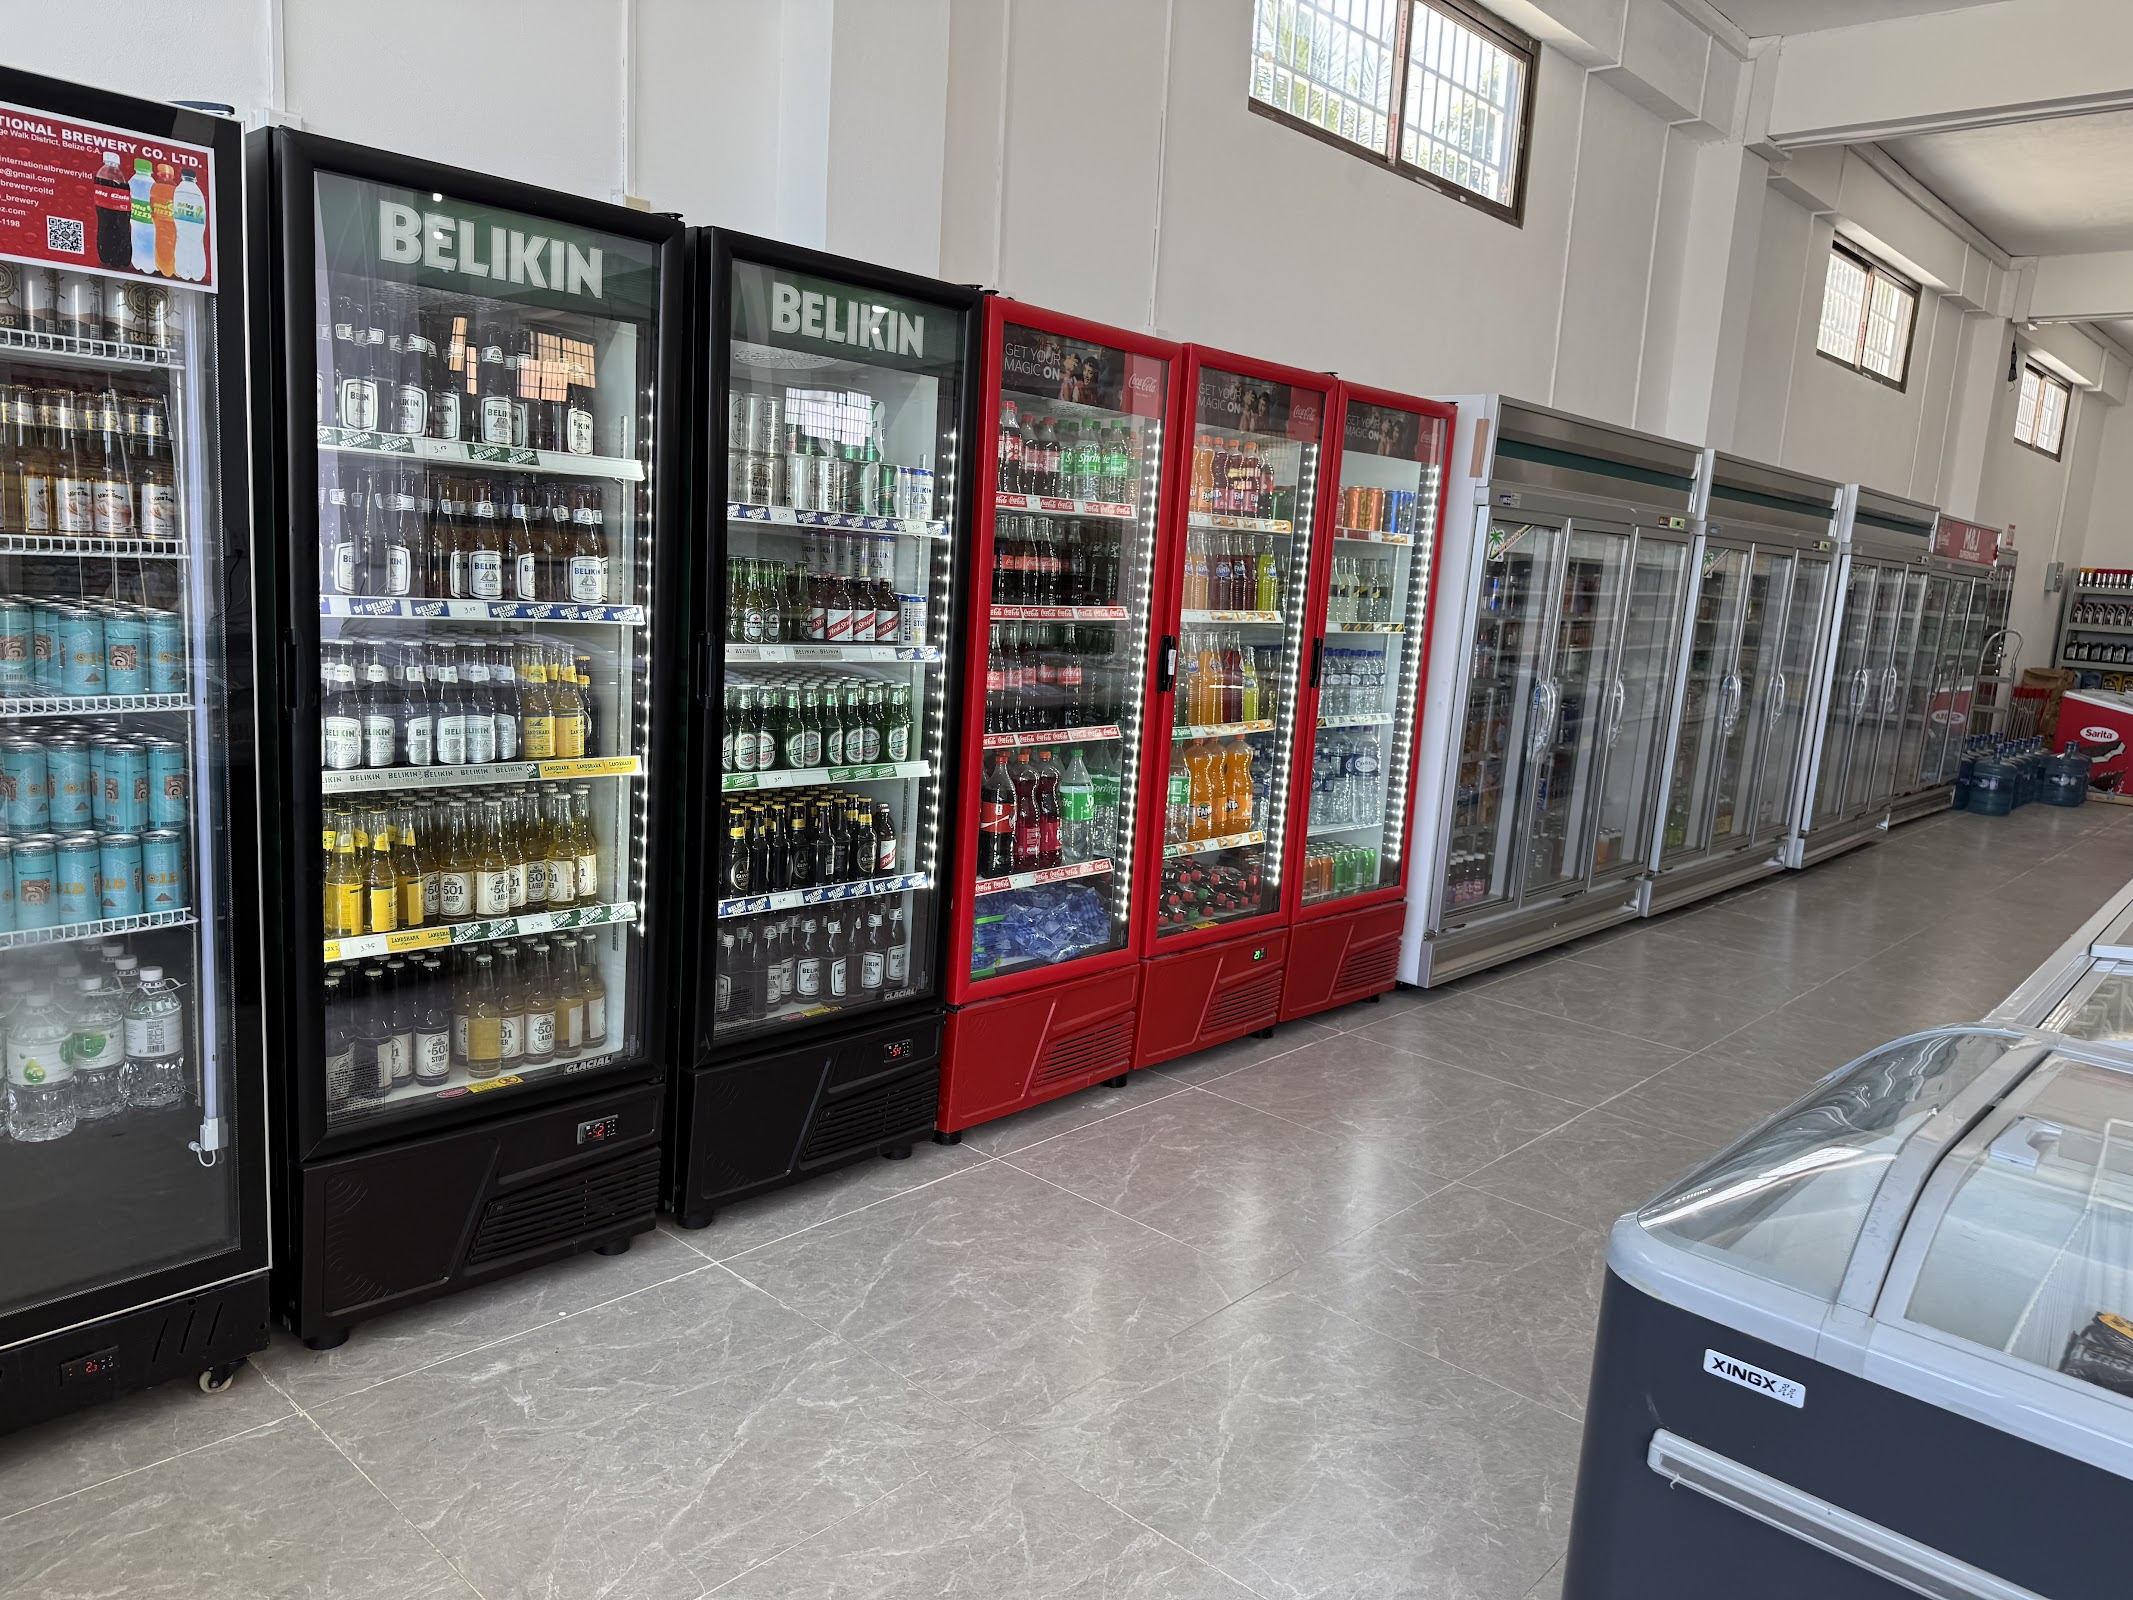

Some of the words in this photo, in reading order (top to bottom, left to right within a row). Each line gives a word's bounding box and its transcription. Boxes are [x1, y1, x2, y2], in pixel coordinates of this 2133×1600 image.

[0, 115, 56, 137] TIONAL
[62, 128, 137, 154] BREWERY
[142, 145, 167, 161] CO.
[172, 152, 203, 168] LTD.
[10, 129, 29, 140] Walk
[31, 134, 60, 147] District,
[62, 140, 85, 151] Belize
[378, 200, 603, 299] BELIKIN
[771, 281, 925, 359] BELIKIN
[1005, 343, 1028, 359] GET
[1031, 347, 1061, 366] YOUR
[1004, 357, 1041, 376] MAGIC
[1043, 366, 1061, 381] ON
[1199, 383, 1217, 396] GET
[1218, 386, 1242, 400] YOUR
[1198, 395, 1226, 411] MAGIC
[1227, 403, 1241, 414] ON
[338, 432, 371, 450] BELIKIN
[1368, 430, 1379, 440] ON
[379, 437, 410, 452] BELIKIN
[471, 447, 500, 462] BELIKIN
[507, 450, 536, 465] BELIKIN
[1963, 527, 1981, 552] M&J
[365, 598, 397, 612] BELIKIN
[414, 600, 444, 615] BELIKIN
[491, 602, 519, 616] BELIKIN
[526, 603, 553, 616] BELIKIN
[581, 606, 606, 619] BELIKIN
[2085, 728, 2113, 740] Sarita
[388, 771, 418, 780] BELIKIN
[424, 769, 453, 778] BELIKIN
[460, 767, 488, 777] BELIKIN
[495, 765, 523, 774] BELIKIN
[350, 773, 381, 782] BELIKIN
[578, 907, 603, 925] BELIKIN
[453, 923, 481, 943] BELIKIN
[487, 919, 515, 939] BELIKIN
[391, 934, 420, 943] LANDSHARK
[885, 986, 917, 1000] GLACIAL
[565, 1055, 612, 1074] GLACIAL
[1711, 1355, 1778, 1394] XINGX
